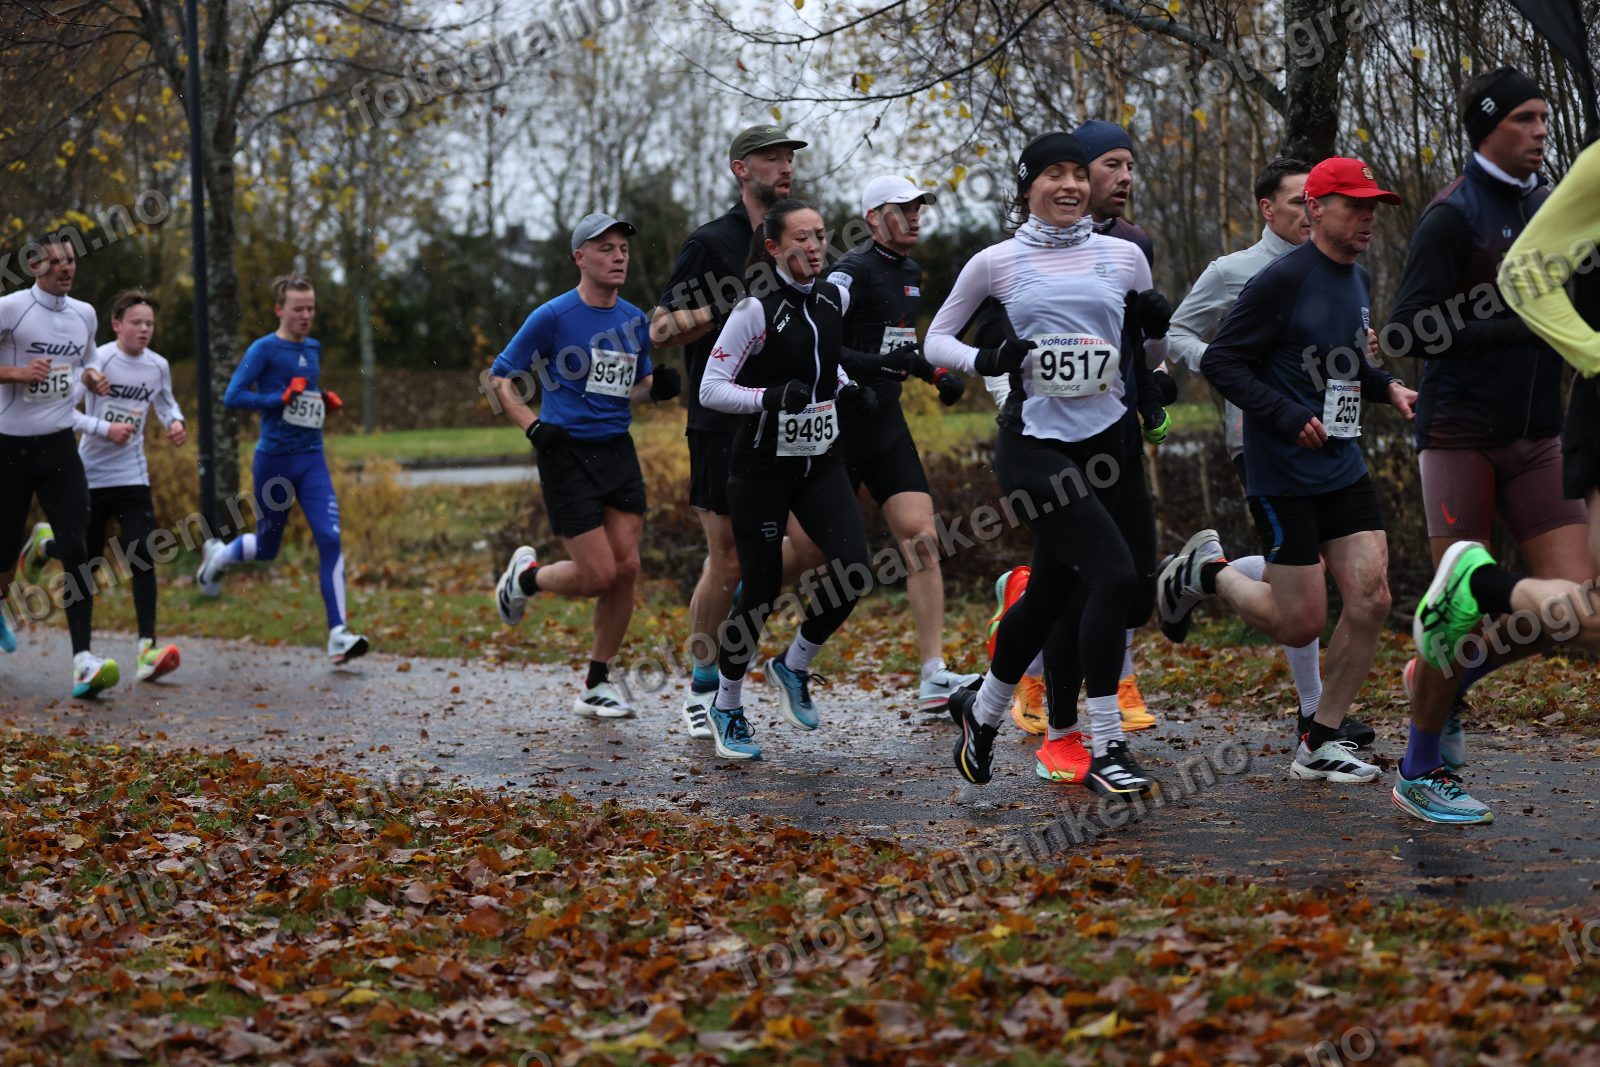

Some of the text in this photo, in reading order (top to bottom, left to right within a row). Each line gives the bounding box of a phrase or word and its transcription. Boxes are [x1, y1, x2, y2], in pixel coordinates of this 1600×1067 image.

[594, 361, 633, 387] 9513
[1040, 350, 1111, 381] 9517
[28, 373, 69, 394] 9515
[1335, 396, 1359, 423] 255
[785, 414, 833, 443] 9495
